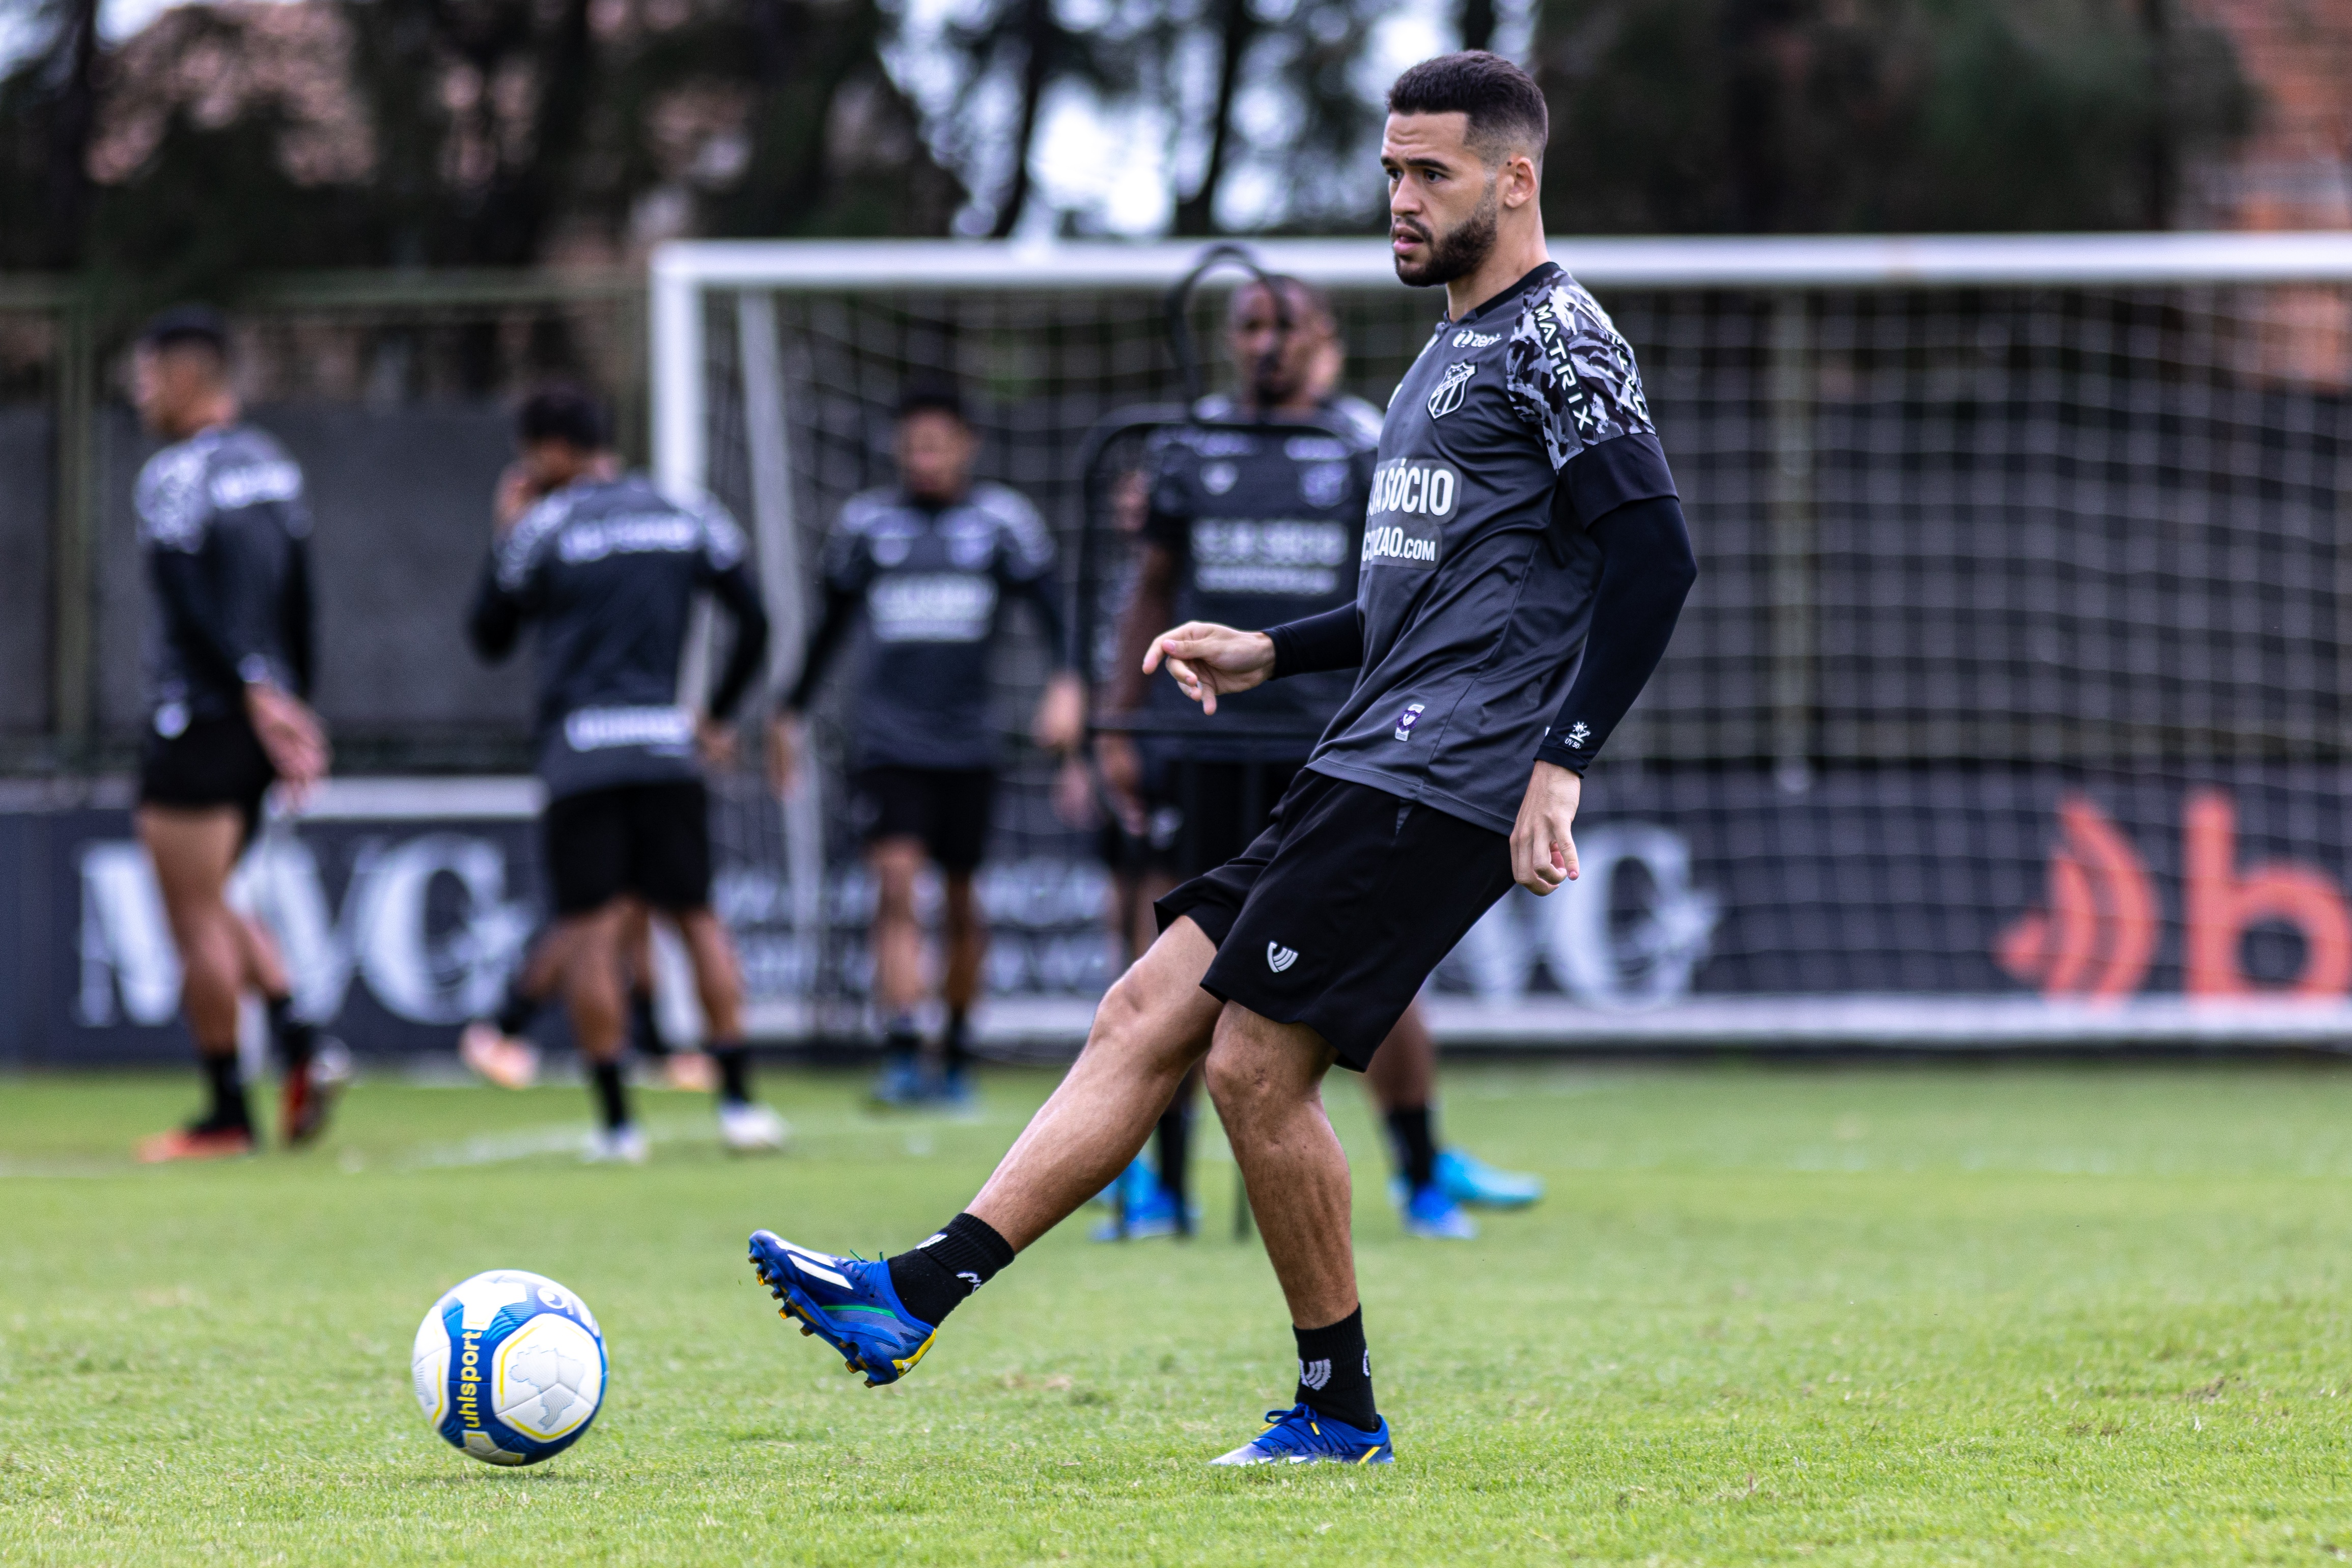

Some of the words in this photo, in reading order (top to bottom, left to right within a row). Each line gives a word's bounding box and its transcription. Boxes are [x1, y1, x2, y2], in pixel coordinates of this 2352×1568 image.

[1534, 304, 1594, 431] MATRIX
[1381, 458, 1454, 516] SÓCIO
[456, 1331, 483, 1428] uhlsport
